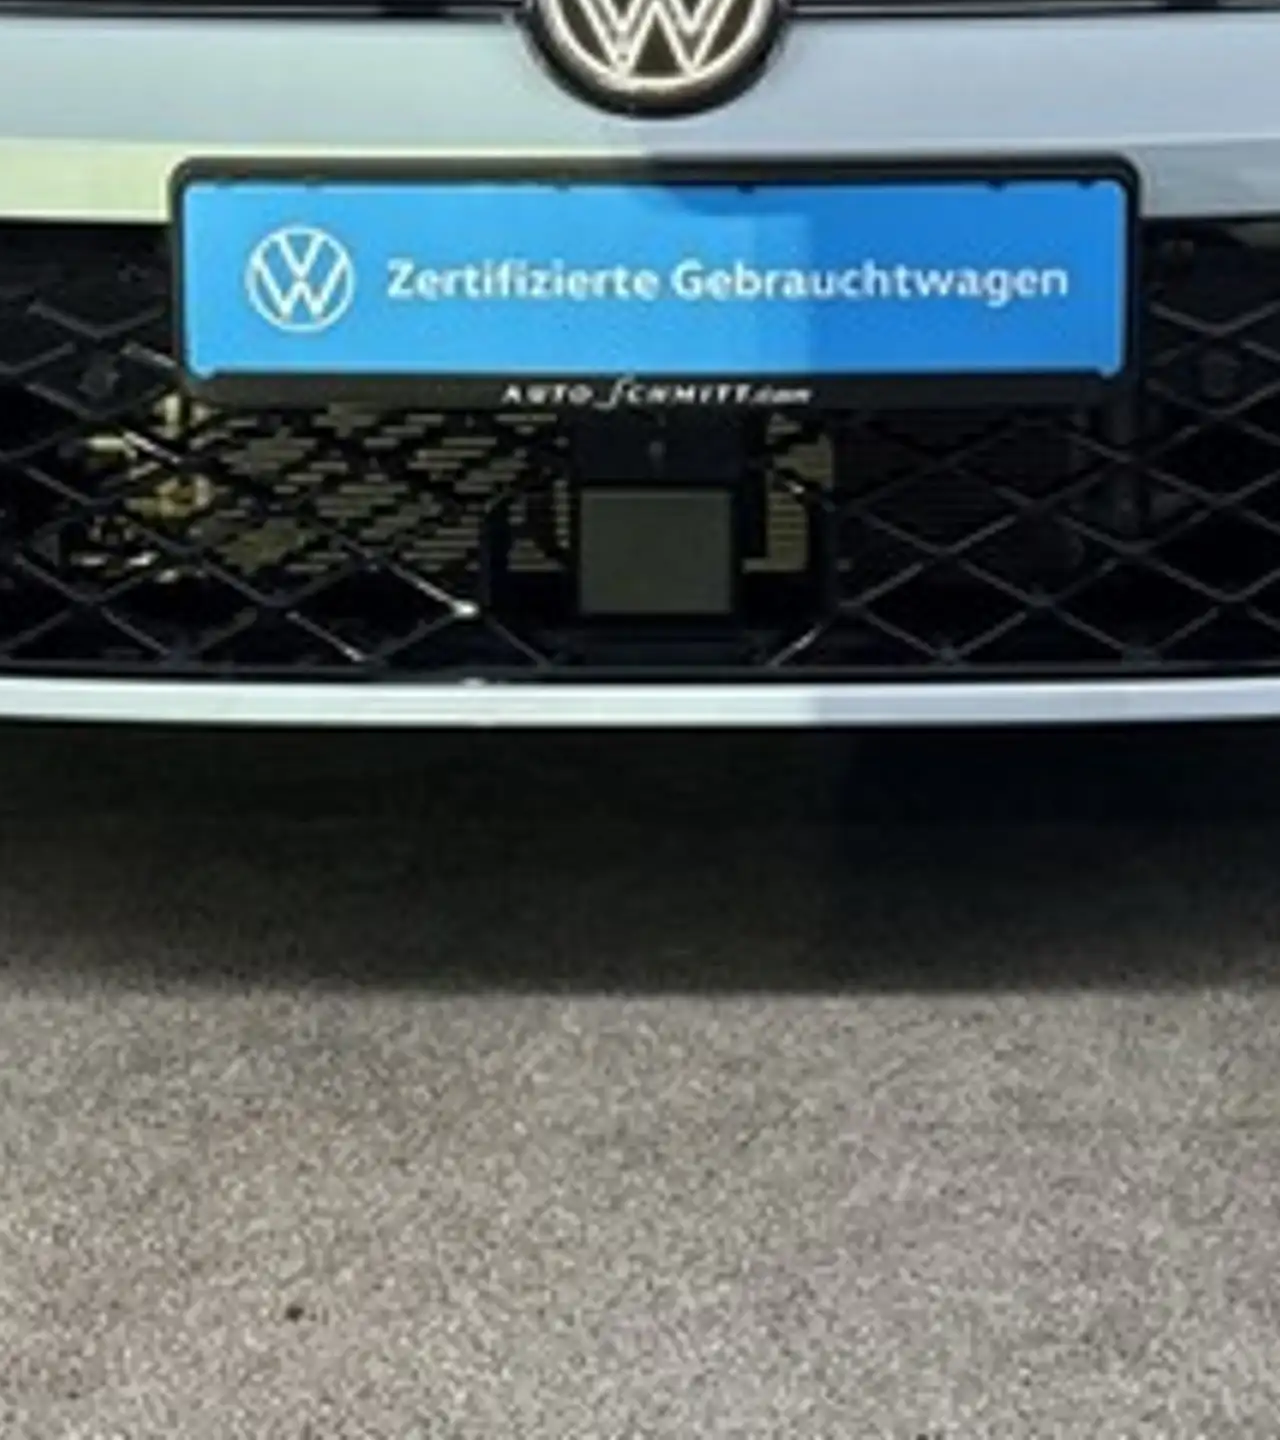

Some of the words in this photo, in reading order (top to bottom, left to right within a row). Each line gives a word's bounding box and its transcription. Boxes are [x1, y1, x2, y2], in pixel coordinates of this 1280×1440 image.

[247, 227, 354, 332] VW
[387, 258, 660, 300] Zertifizierte
[670, 258, 1068, 308] Gebrauchtwagen
[501, 383, 594, 405] AUTO
